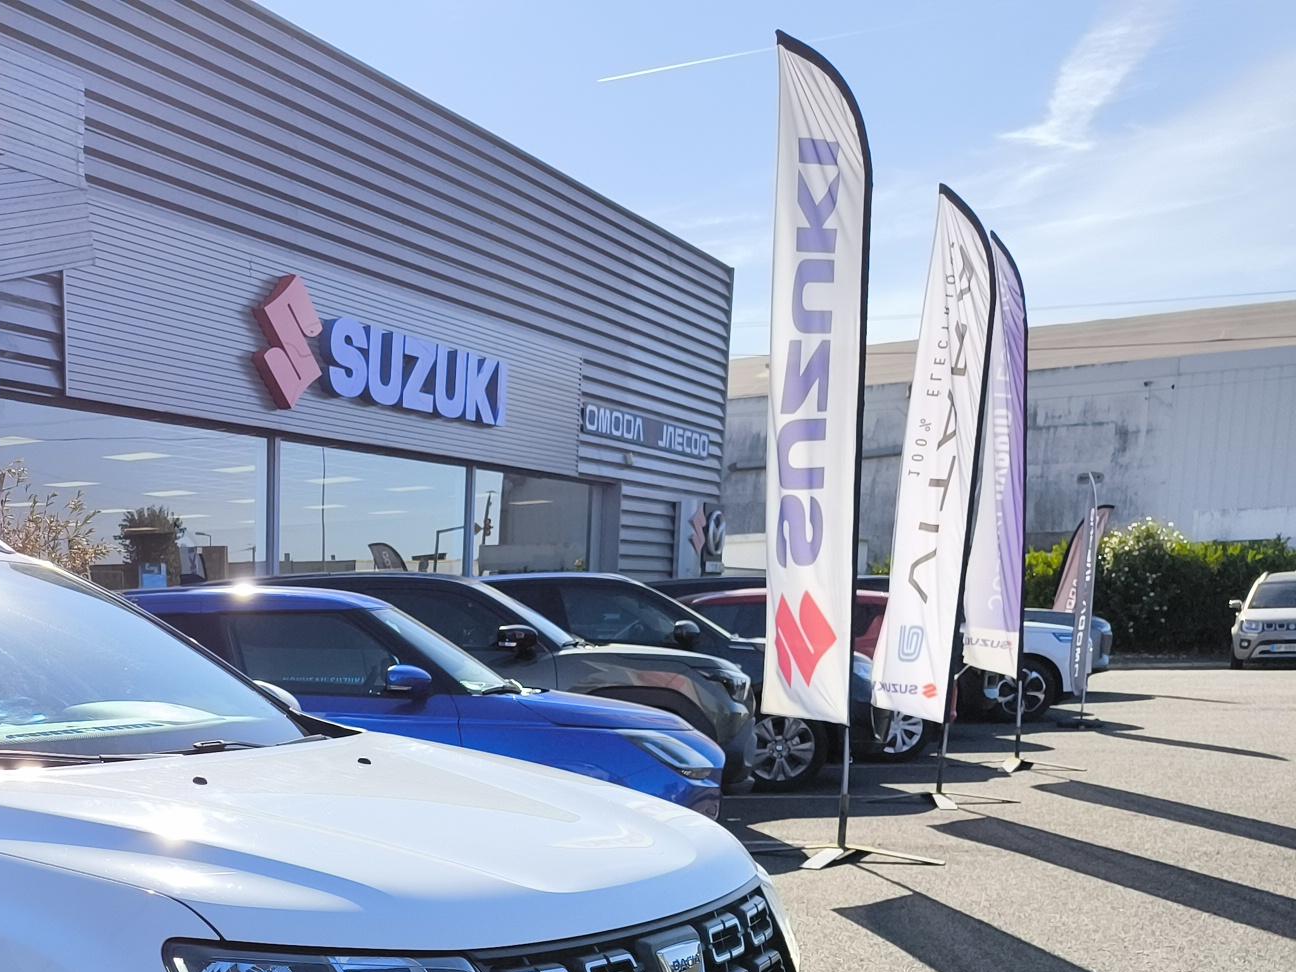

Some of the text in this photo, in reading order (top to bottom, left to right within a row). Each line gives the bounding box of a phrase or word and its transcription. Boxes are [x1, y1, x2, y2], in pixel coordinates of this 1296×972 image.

[328, 317, 509, 427] SUZUKI
[585, 404, 709, 458] OMODA JAECOO
